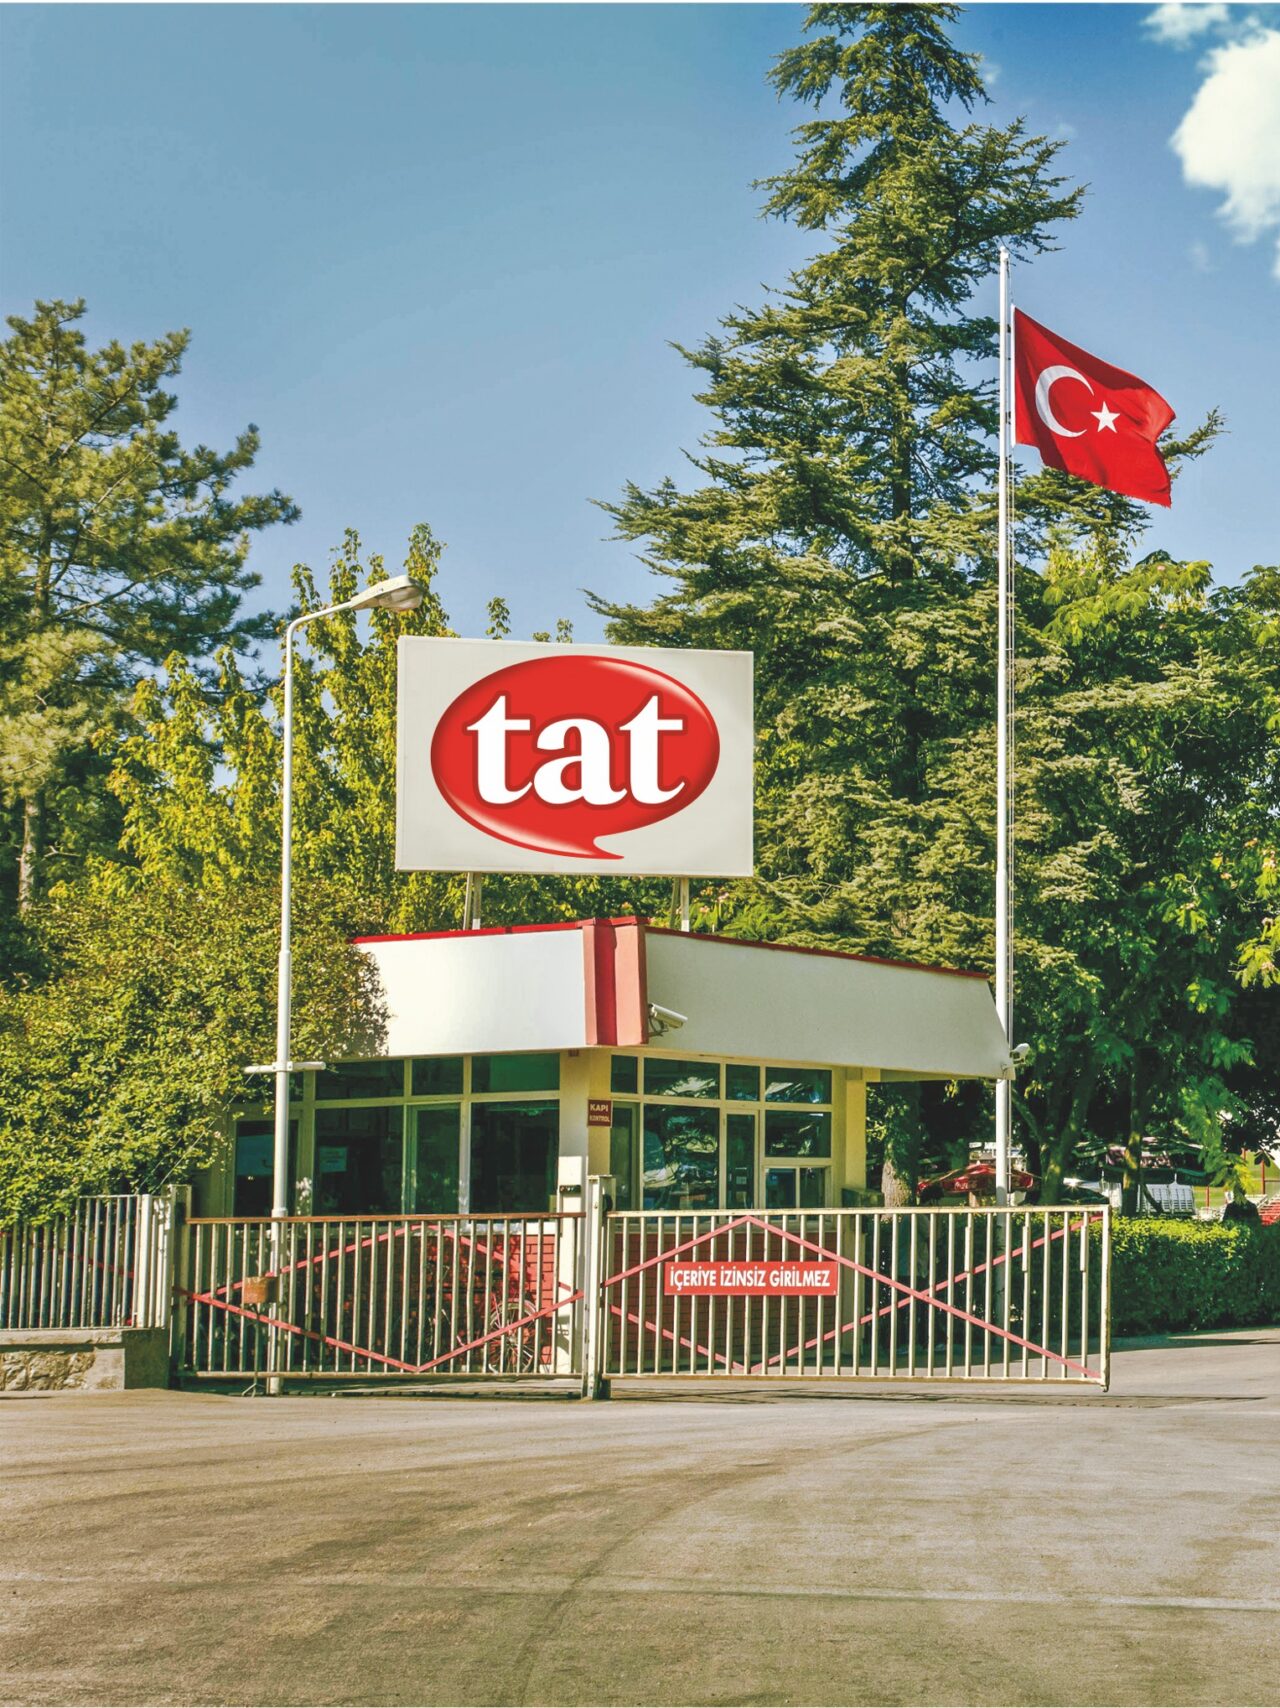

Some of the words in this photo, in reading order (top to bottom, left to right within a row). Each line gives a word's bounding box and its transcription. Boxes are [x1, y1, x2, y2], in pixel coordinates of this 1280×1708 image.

[466, 695, 685, 806] tat
[590, 1104, 609, 1112] KAPI
[670, 1266, 717, 1291] İÇERİYE
[720, 1266, 766, 1287] İZİNSİZ
[769, 1266, 831, 1287] GİRİLMEZ
